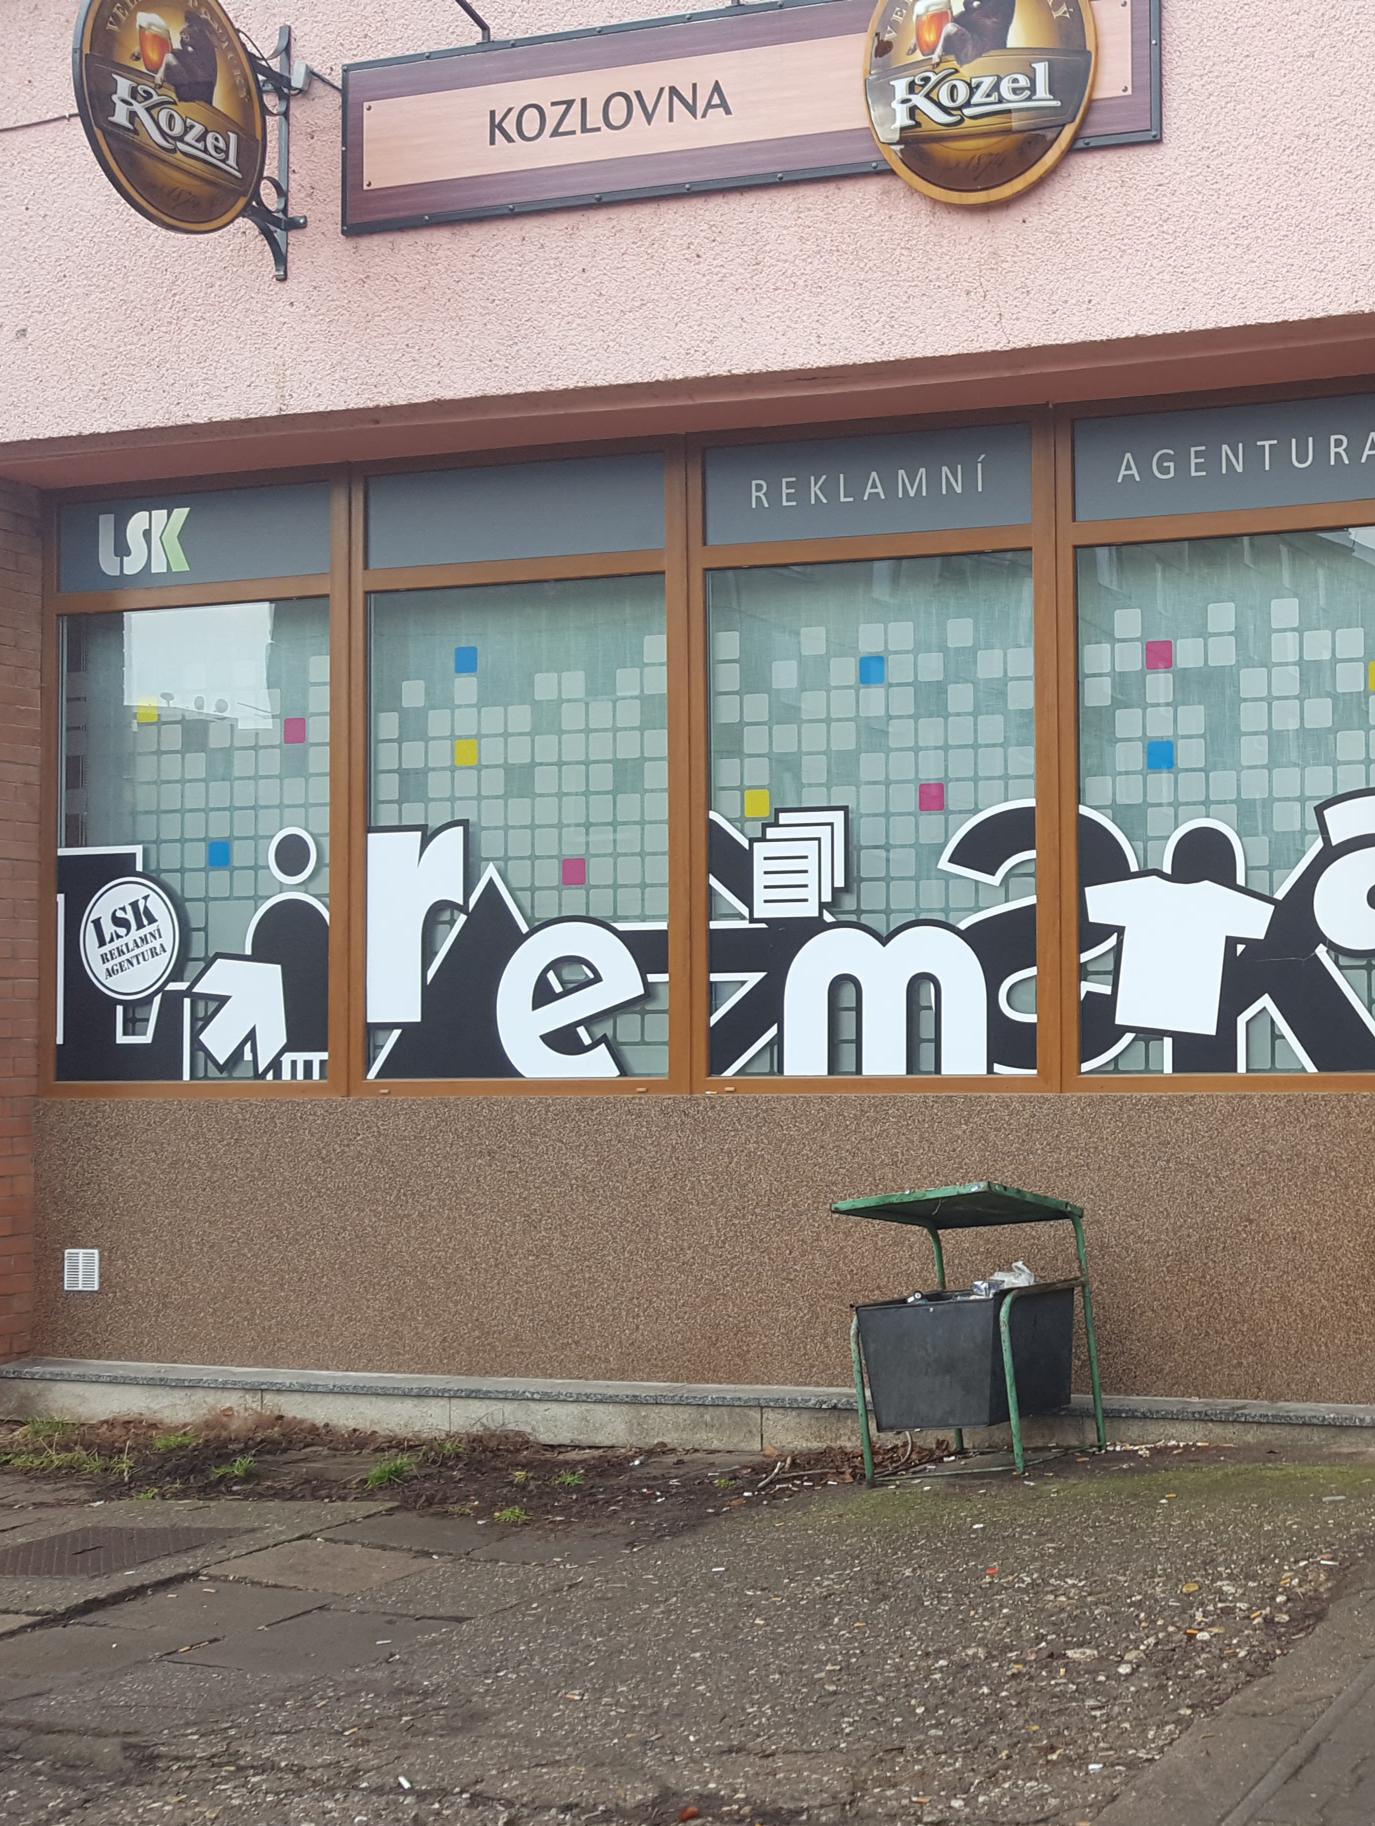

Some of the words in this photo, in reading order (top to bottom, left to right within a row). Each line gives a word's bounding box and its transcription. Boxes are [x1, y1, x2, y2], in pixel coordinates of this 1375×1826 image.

[107, 73, 242, 178] Kozel
[488, 79, 733, 146] KOZLOVNA
[889, 61, 1062, 130] Kozel
[751, 454, 987, 509] REKLAMNÍ
[98, 507, 191, 576] LSK
[91, 893, 159, 950] LSK
[100, 925, 164, 965] REKLAMNÍ
[105, 942, 168, 981] AGENTURA
